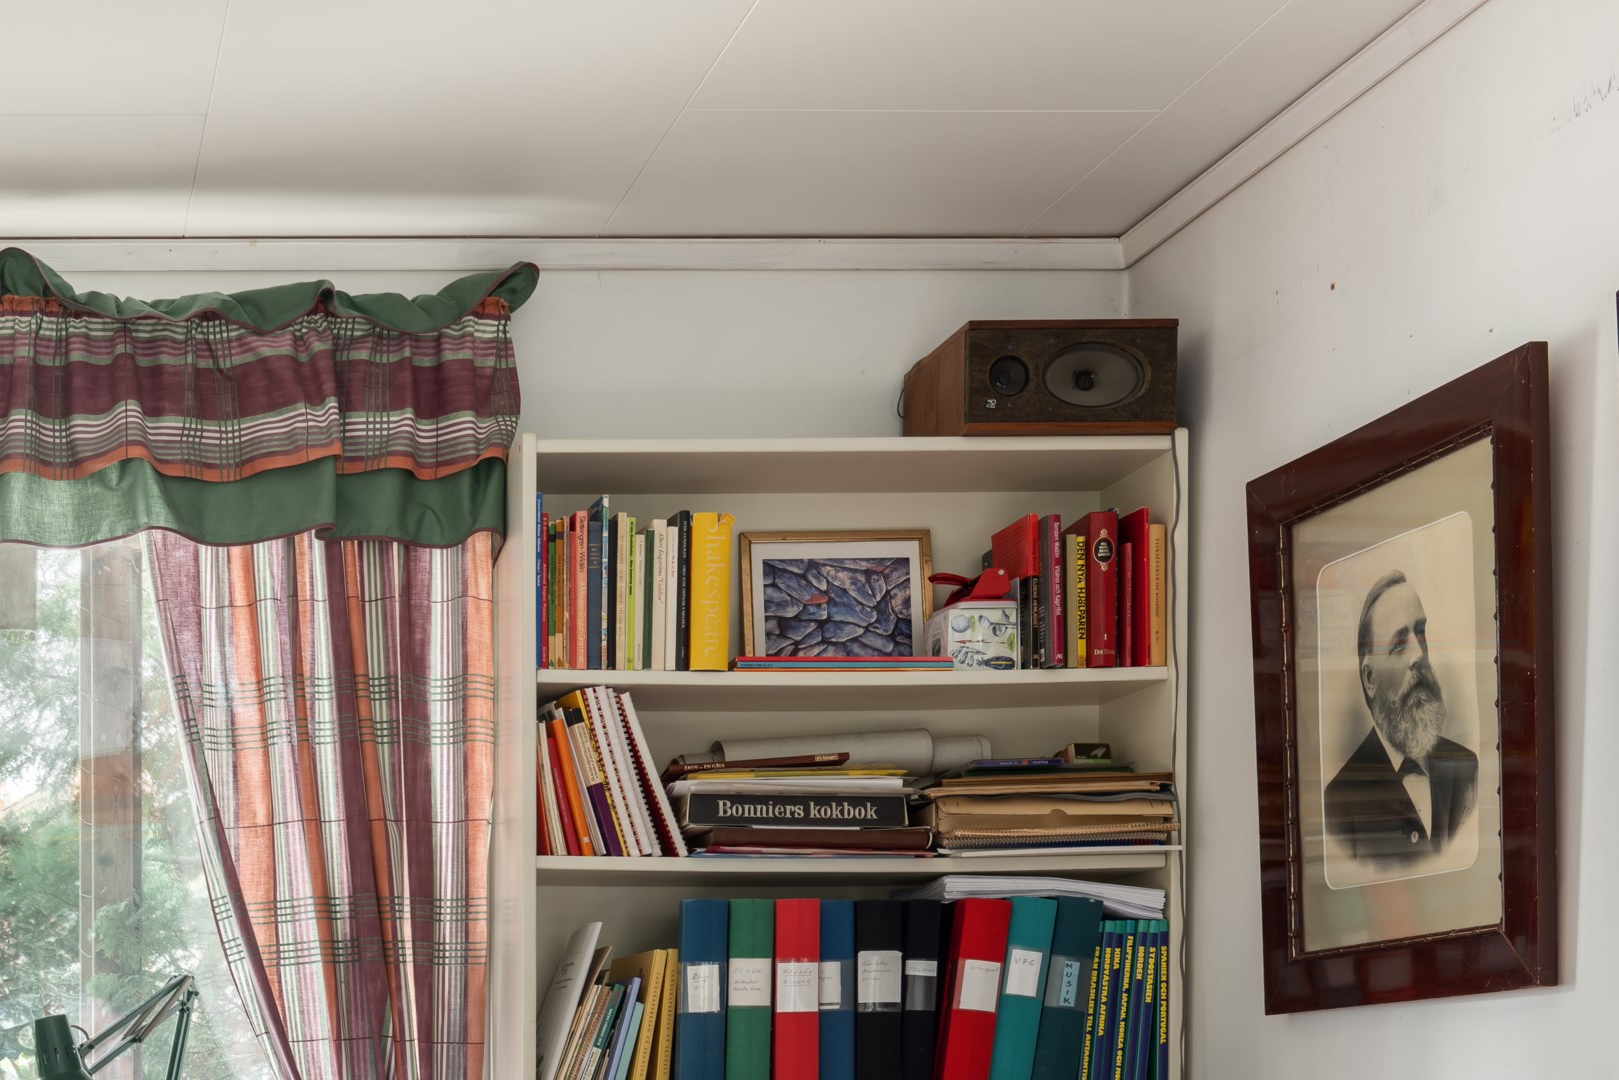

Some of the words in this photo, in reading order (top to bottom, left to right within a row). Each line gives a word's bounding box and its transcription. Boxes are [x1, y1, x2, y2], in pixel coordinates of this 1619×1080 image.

[1077, 541, 1085, 560] DEN
[700, 517, 728, 658] Shakespeare
[1077, 564, 1085, 584] NYA
[716, 799, 804, 818] Bonniers
[808, 801, 878, 820] kokbok
[1100, 947, 1112, 1003] NORDVÄSTRA
[1112, 947, 1121, 970] KINA
[1122, 936, 1134, 991] FILIPPINERNA,
[1136, 946, 1145, 980] NORDEN
[1145, 946, 1156, 1003] SYDOSTASIEN
[1063, 962, 1073, 1005] MUSIK
[1088, 970, 1098, 1014] BRASILIEN
[1097, 1004, 1107, 1036] AFRIKA
[1081, 1034, 1092, 1080] ANTARKTIS
